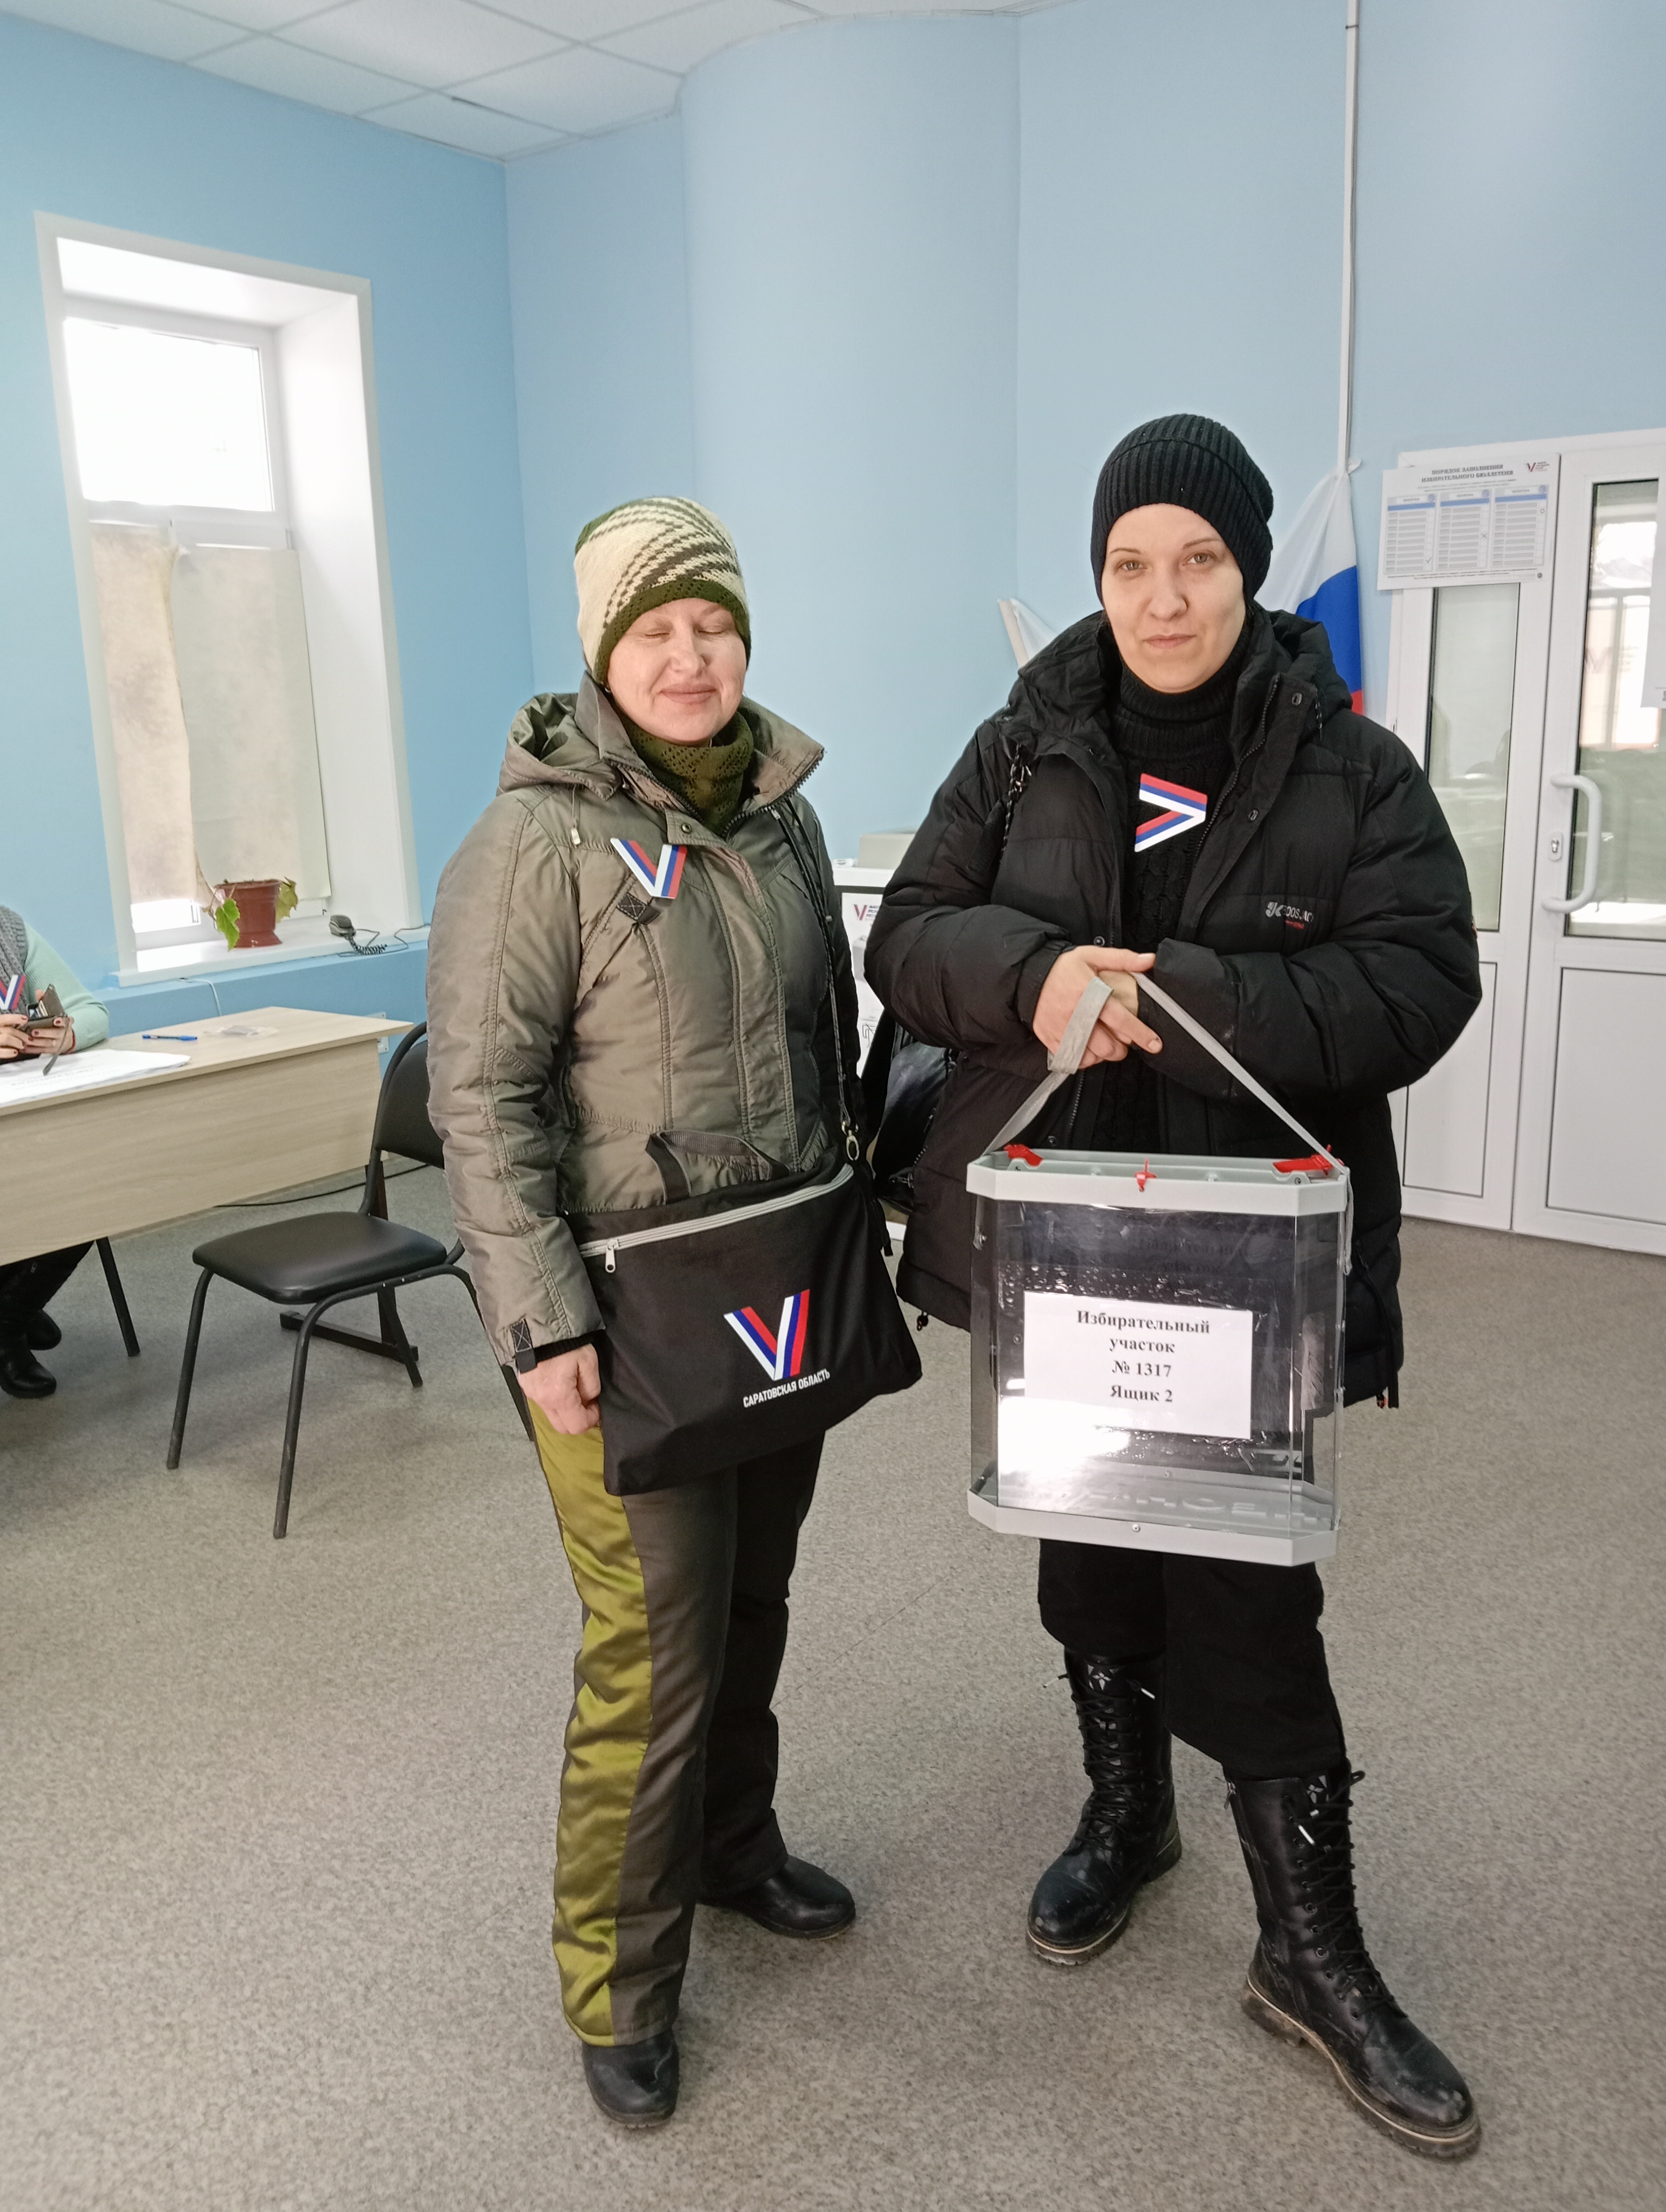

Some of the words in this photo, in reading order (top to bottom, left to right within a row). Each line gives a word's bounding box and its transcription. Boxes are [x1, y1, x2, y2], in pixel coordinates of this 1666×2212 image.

[1077, 1310, 1210, 1334] Избирательный
[1109, 1338, 1175, 1353] участок
[1112, 1360, 1130, 1374] №
[1136, 1362, 1172, 1378] 1317
[743, 1381, 797, 1408] САРАТОВСКАЯ
[798, 1368, 831, 1390] ОБЛАСТЬ
[1110, 1385, 1160, 1401] Ящик
[1165, 1390, 1173, 1403] 2
